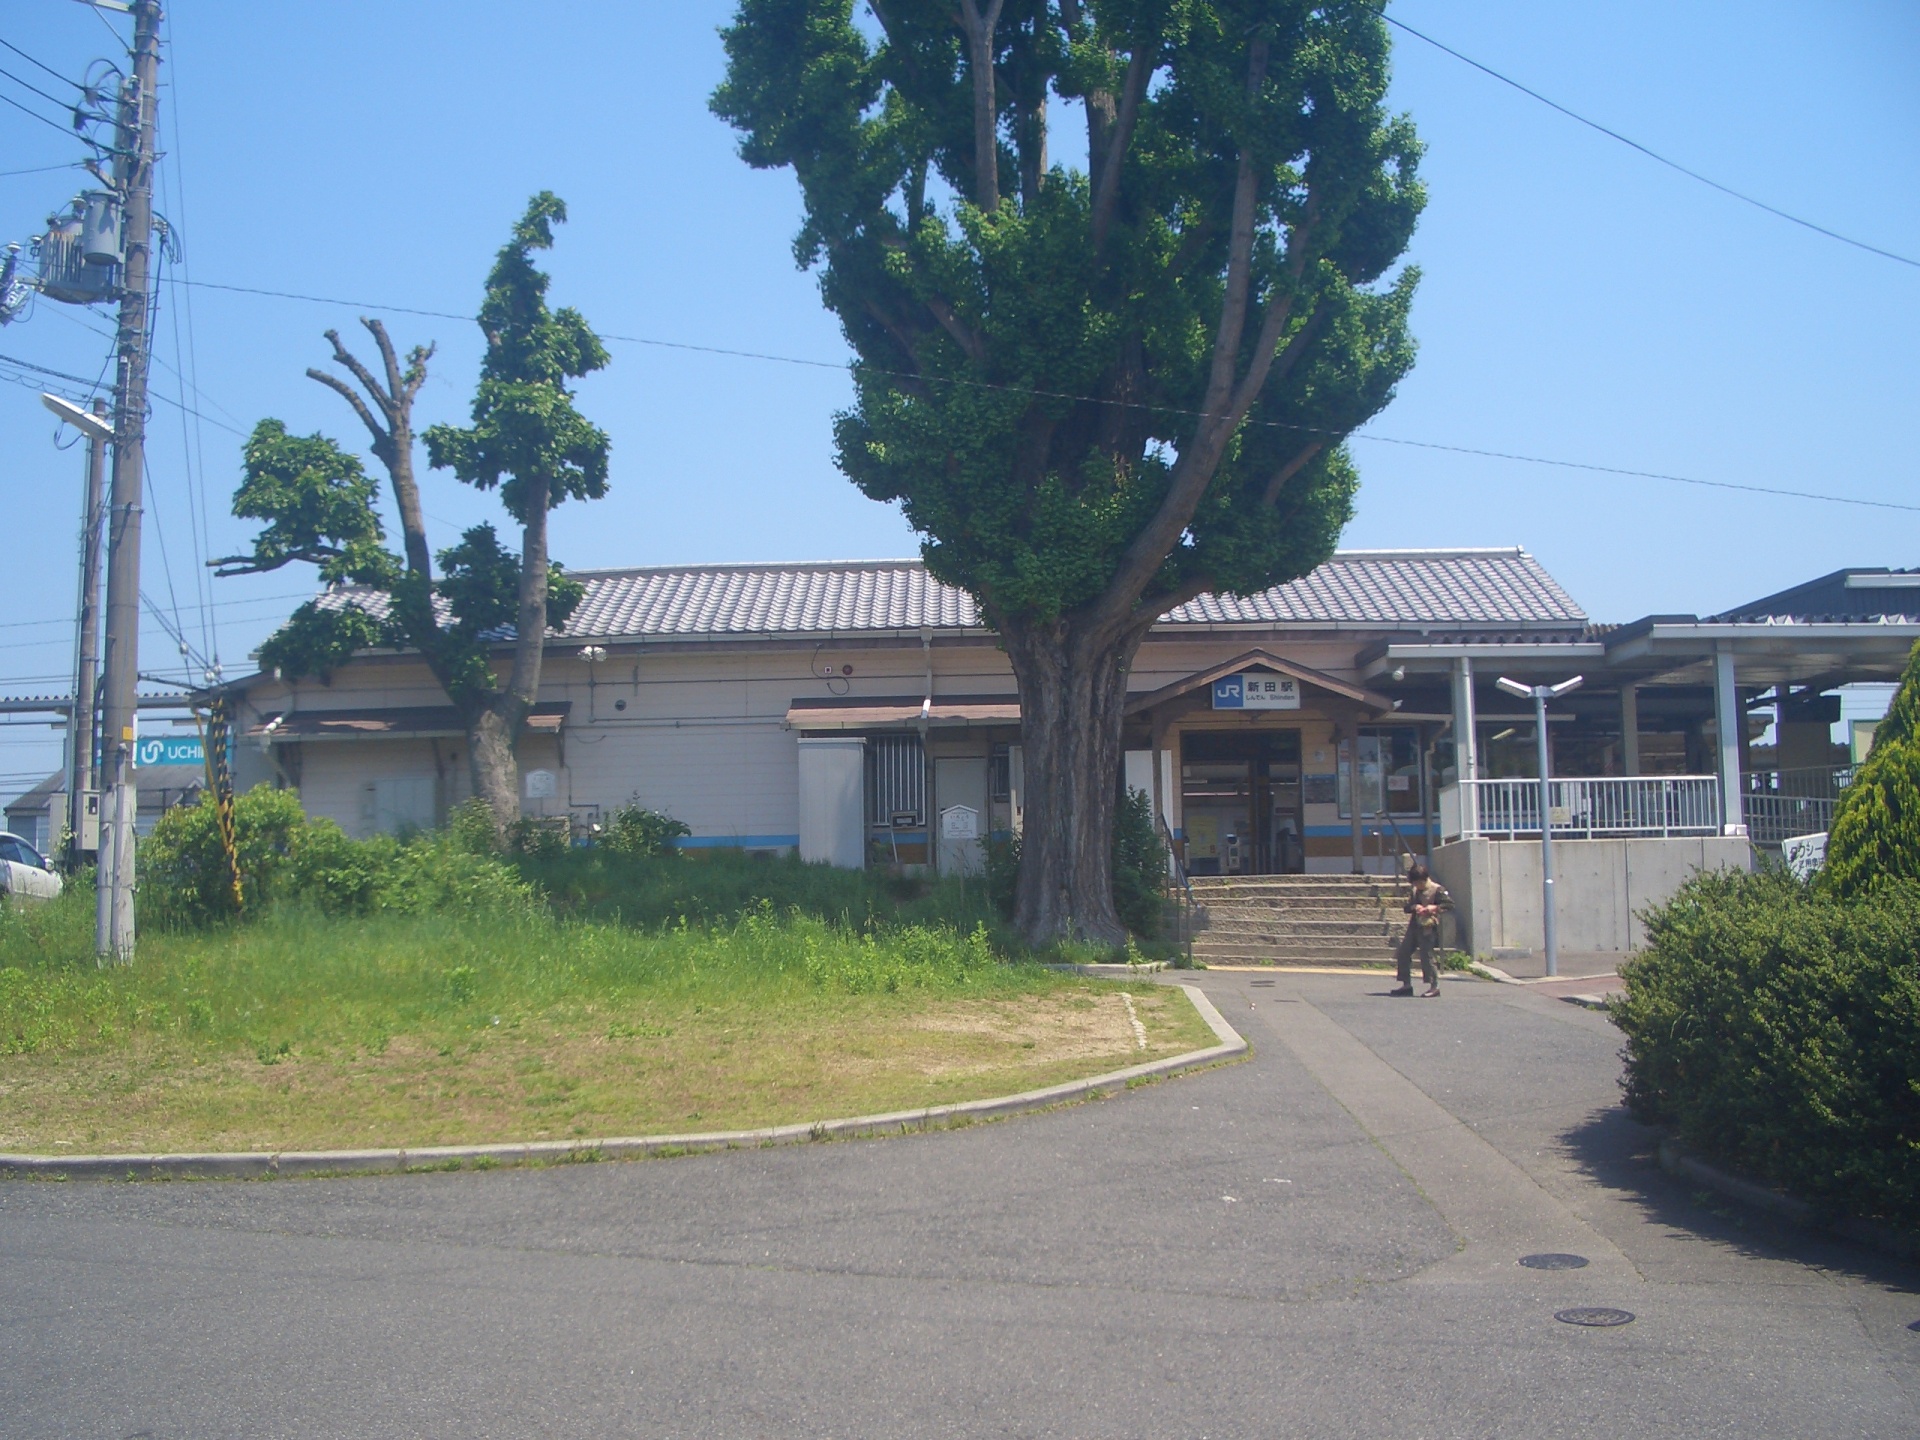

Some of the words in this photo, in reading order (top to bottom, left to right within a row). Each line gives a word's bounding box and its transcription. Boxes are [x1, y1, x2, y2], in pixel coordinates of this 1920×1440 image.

[1217, 685, 1240, 698] JR
[1247, 681, 1293, 692] 新田駅
